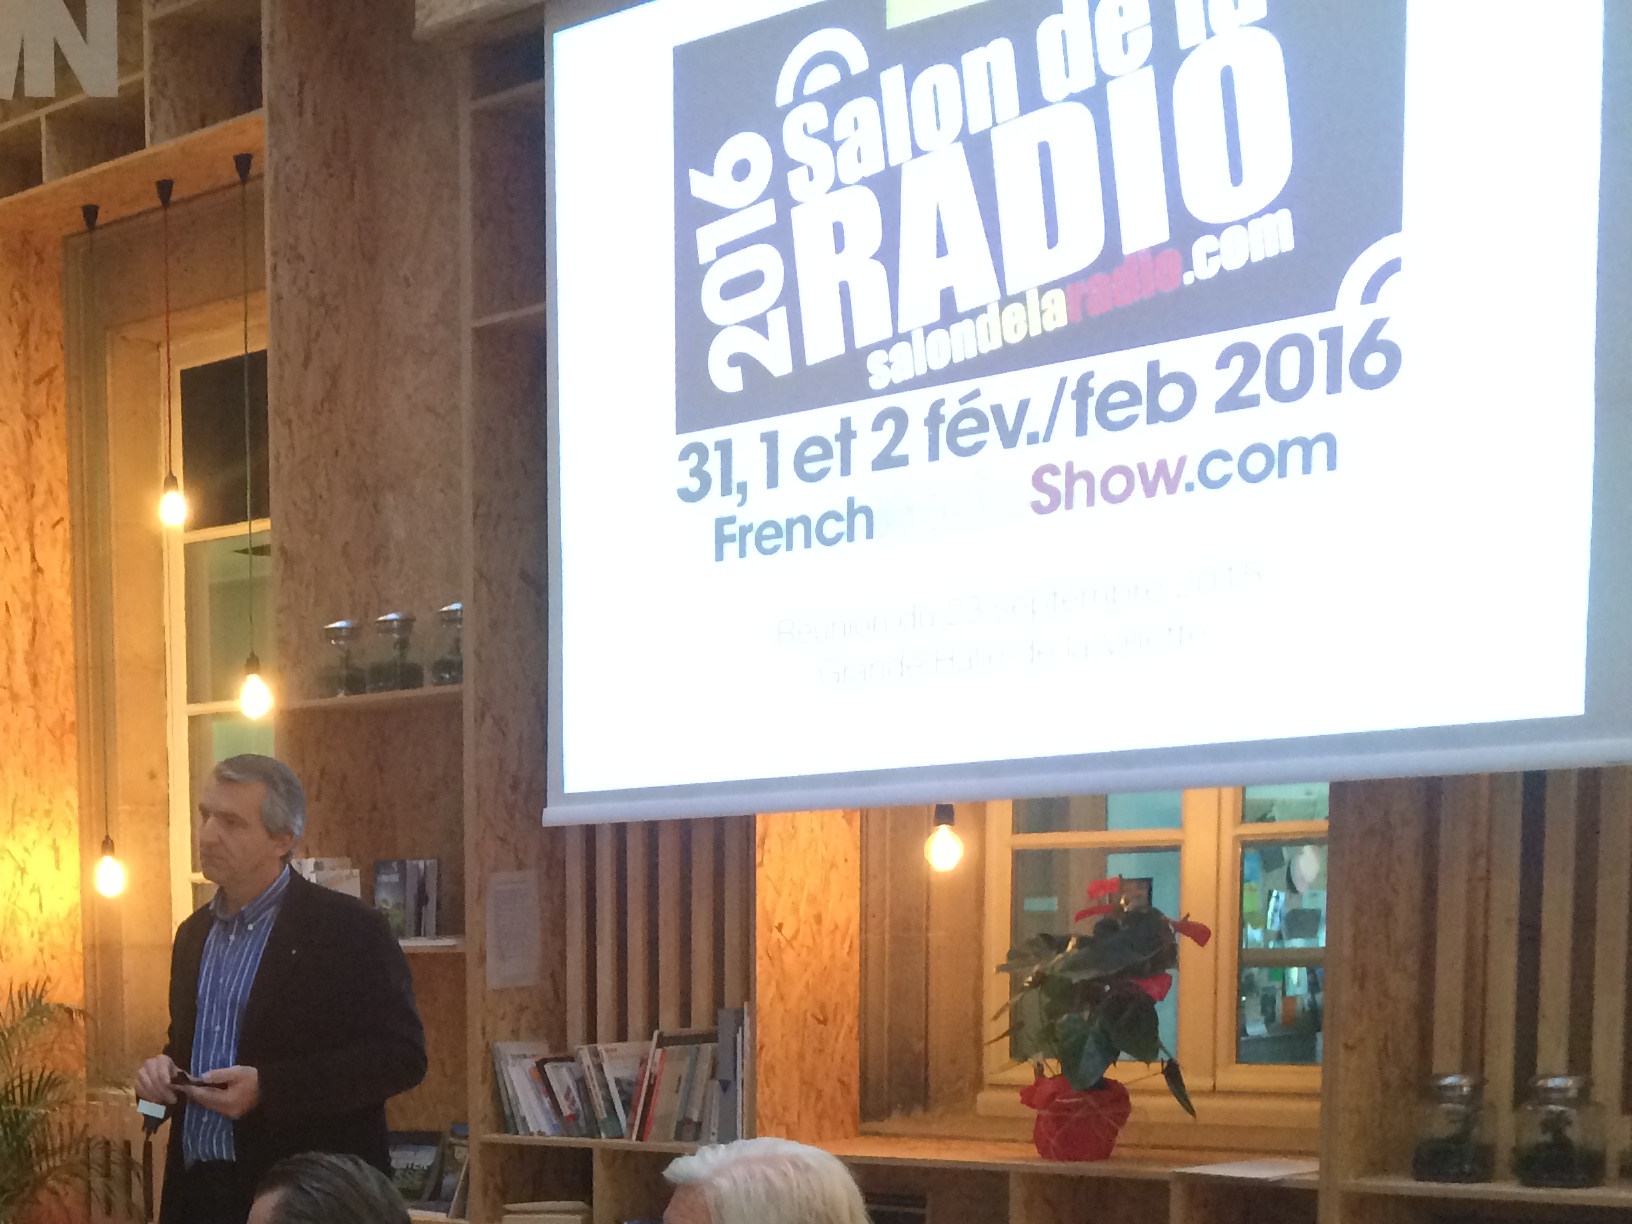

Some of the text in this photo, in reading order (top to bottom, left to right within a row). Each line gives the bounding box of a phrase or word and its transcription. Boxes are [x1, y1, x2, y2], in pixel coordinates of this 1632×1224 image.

[782, 37, 1020, 203] Salon
[1036, 0, 1152, 102] de
[790, 25, 1293, 366] RADIO
[689, 131, 792, 393] 2016
[866, 208, 1295, 390] salondelaradio.com
[713, 495, 874, 563] French
[1029, 432, 1338, 516] Show.com
[760, 430, 778, 489] 1
[793, 416, 857, 484] et
[870, 405, 909, 472] 2
[925, 360, 1198, 464] fév./feb
[1215, 316, 1402, 416] 2016
